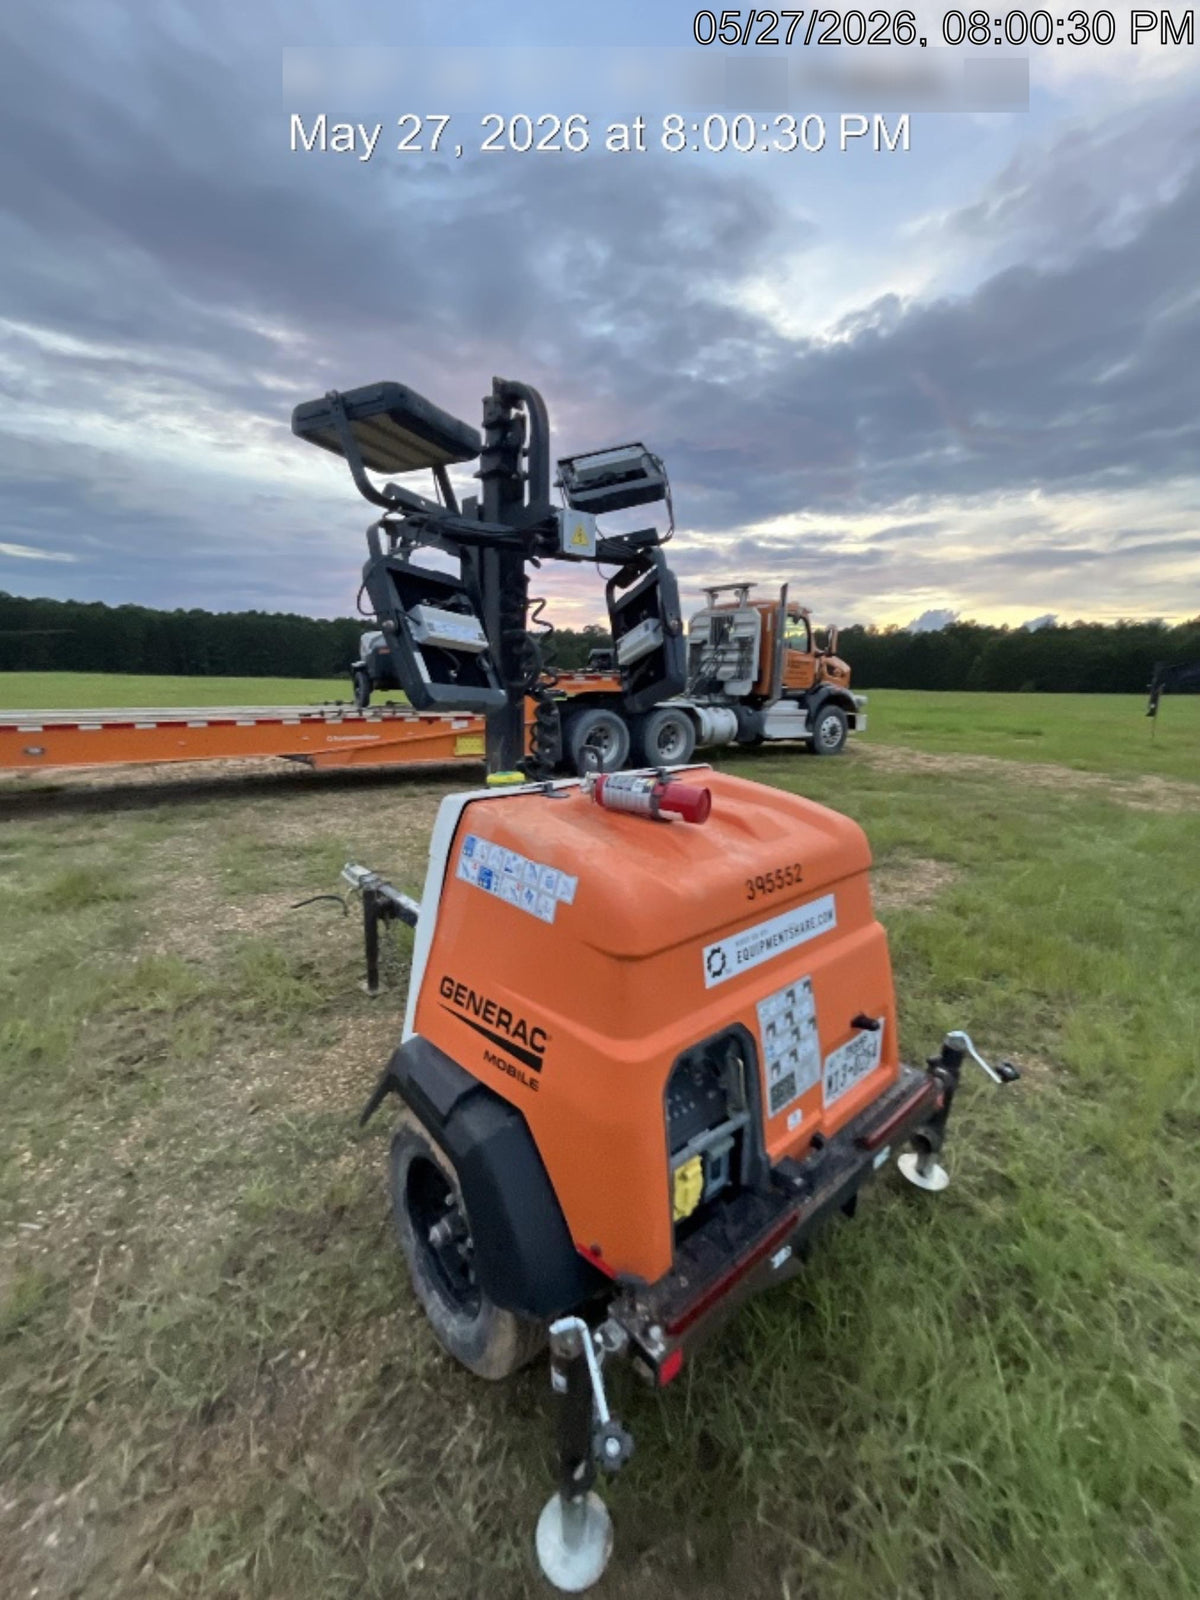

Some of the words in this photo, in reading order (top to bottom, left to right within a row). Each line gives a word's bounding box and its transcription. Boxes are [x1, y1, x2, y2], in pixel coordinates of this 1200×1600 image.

[745, 863, 803, 901] 395552
[736, 909, 834, 965] EQUIPMENTSHARE.COM
[440, 976, 547, 1054] GENERAC
[483, 1050, 540, 1092] MOBILE
